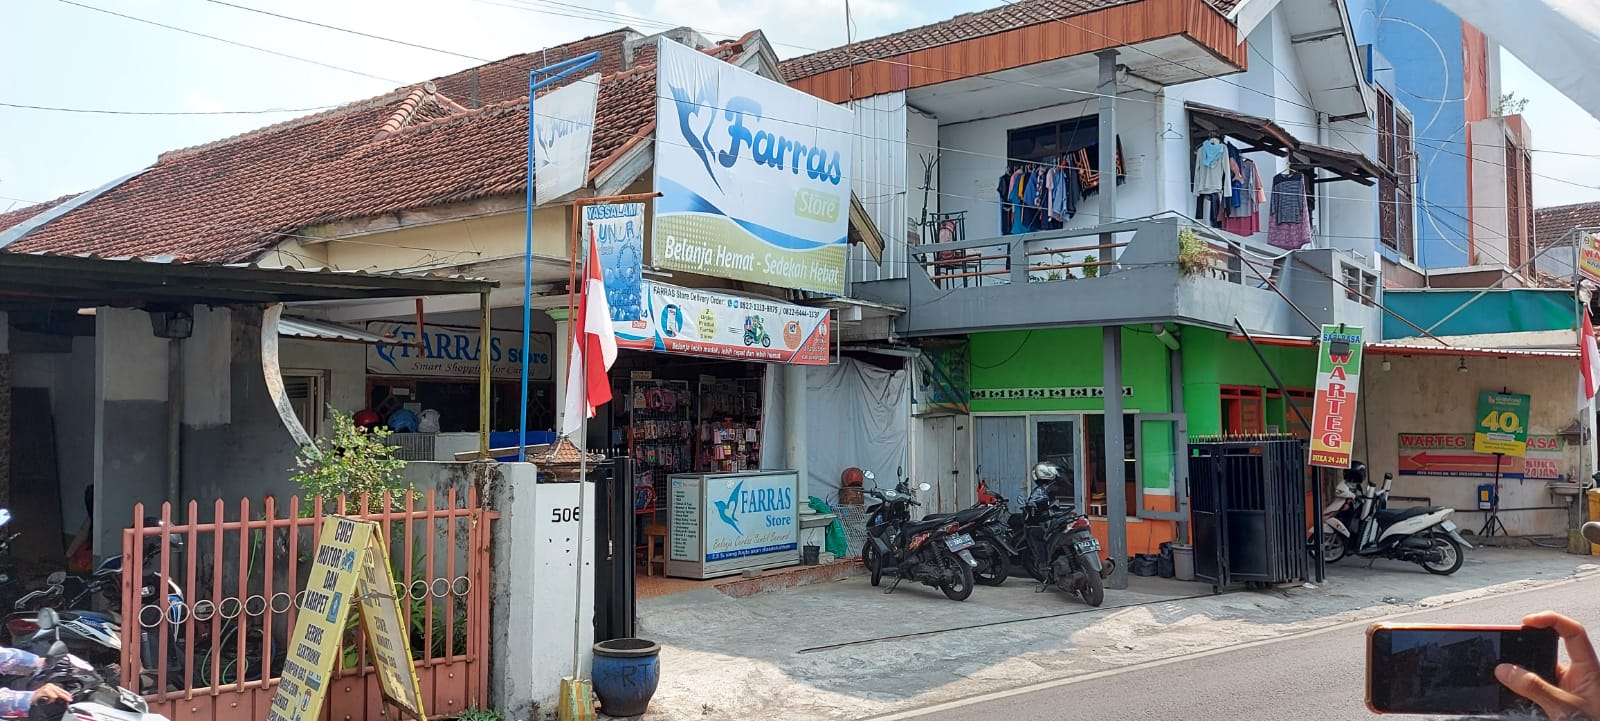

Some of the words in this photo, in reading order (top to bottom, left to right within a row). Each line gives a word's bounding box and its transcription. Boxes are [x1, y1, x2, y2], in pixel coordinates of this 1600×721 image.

[719, 96, 841, 185] Farras
[800, 191, 837, 218] Store
[664, 235, 712, 271] Belanja
[716, 249, 755, 271] Hemat
[763, 255, 806, 282] Sedekah
[810, 262, 840, 285] Hebat
[653, 286, 675, 298] FARRAS
[412, 361, 442, 371] Smart
[1401, 435, 1466, 447] WARTEG
[741, 487, 791, 514] FARRAS
[334, 521, 356, 543] CUCI
[766, 515, 791, 528] Store
[317, 544, 342, 568] MOTOR
[323, 570, 340, 592] DAN
[304, 589, 329, 615] KARPET
[304, 623, 325, 645] SERVIS
